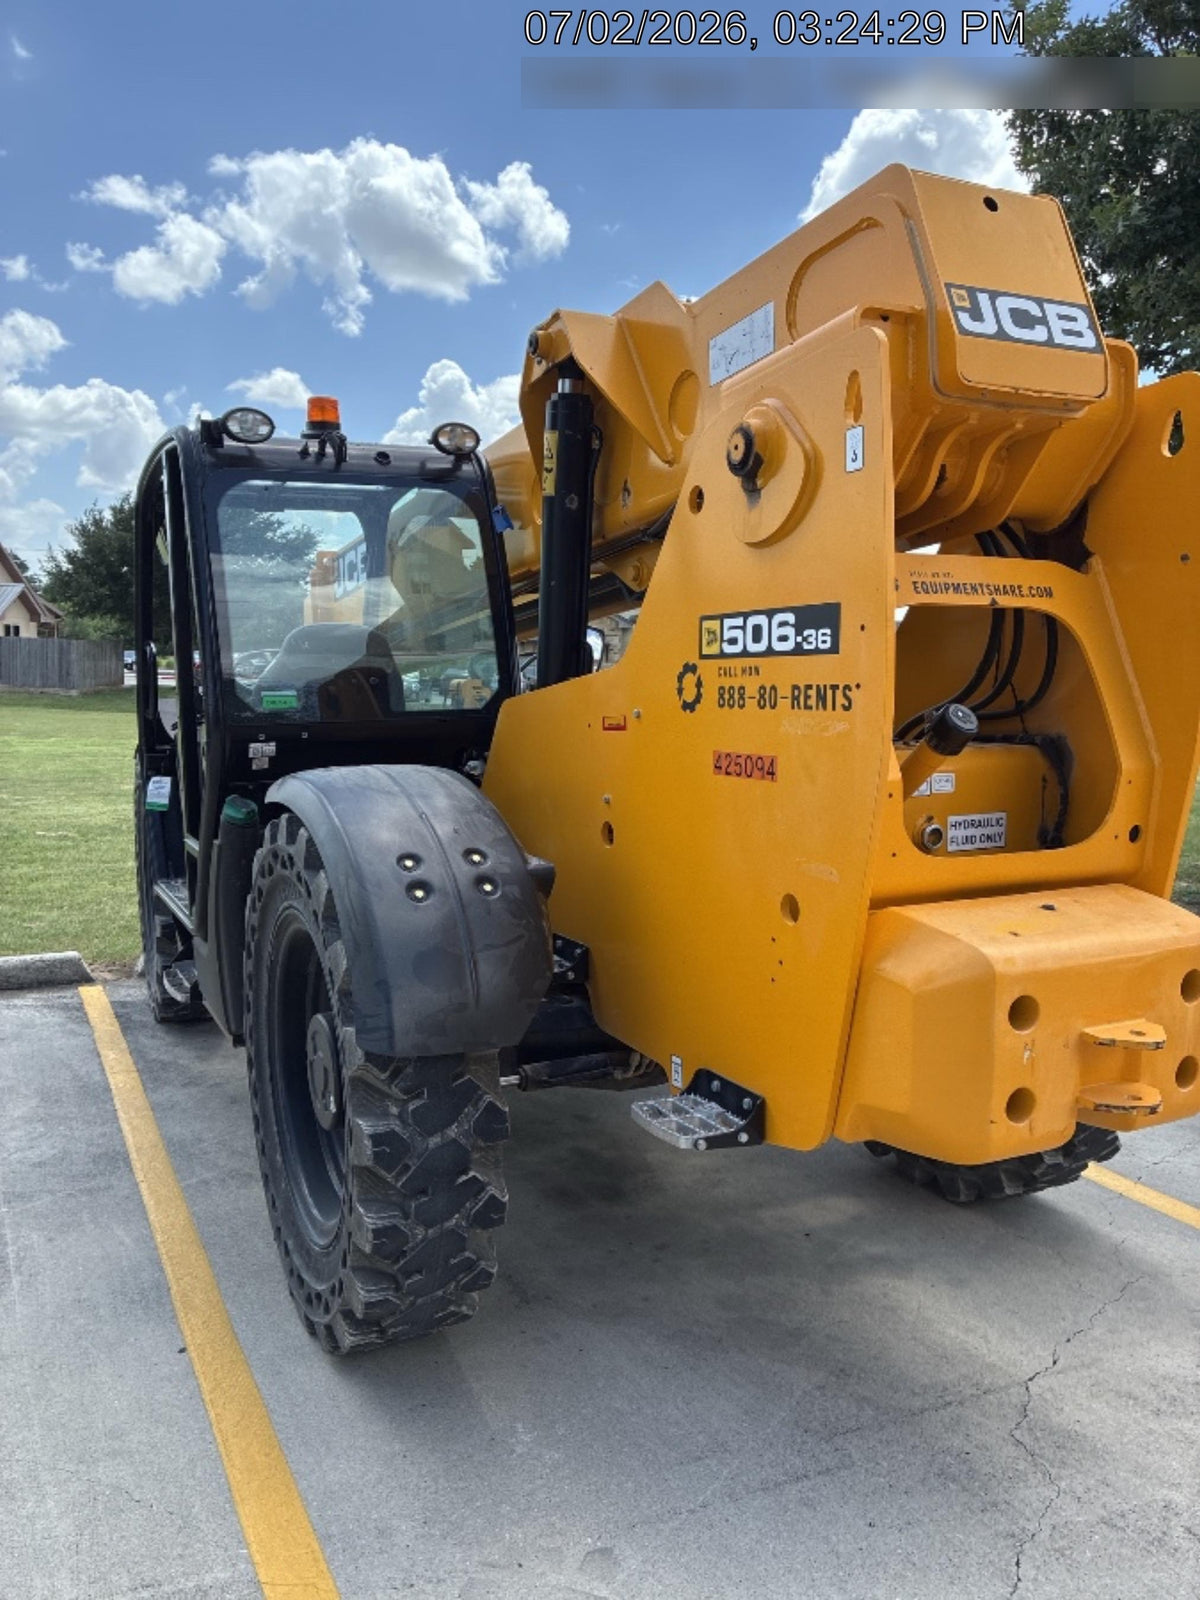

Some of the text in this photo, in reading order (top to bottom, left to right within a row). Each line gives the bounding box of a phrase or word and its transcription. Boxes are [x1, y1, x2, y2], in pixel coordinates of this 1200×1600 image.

[957, 291, 1096, 348] JCB
[912, 581, 1053, 598] EQUIPMENTSHARE.COM
[718, 665, 737, 678] CALL
[717, 684, 853, 711] 888-80-RENTS
[714, 753, 776, 781] 425094
[950, 817, 1003, 831] HYDRAULIC
[950, 832, 1004, 847] FLUID ONLY
